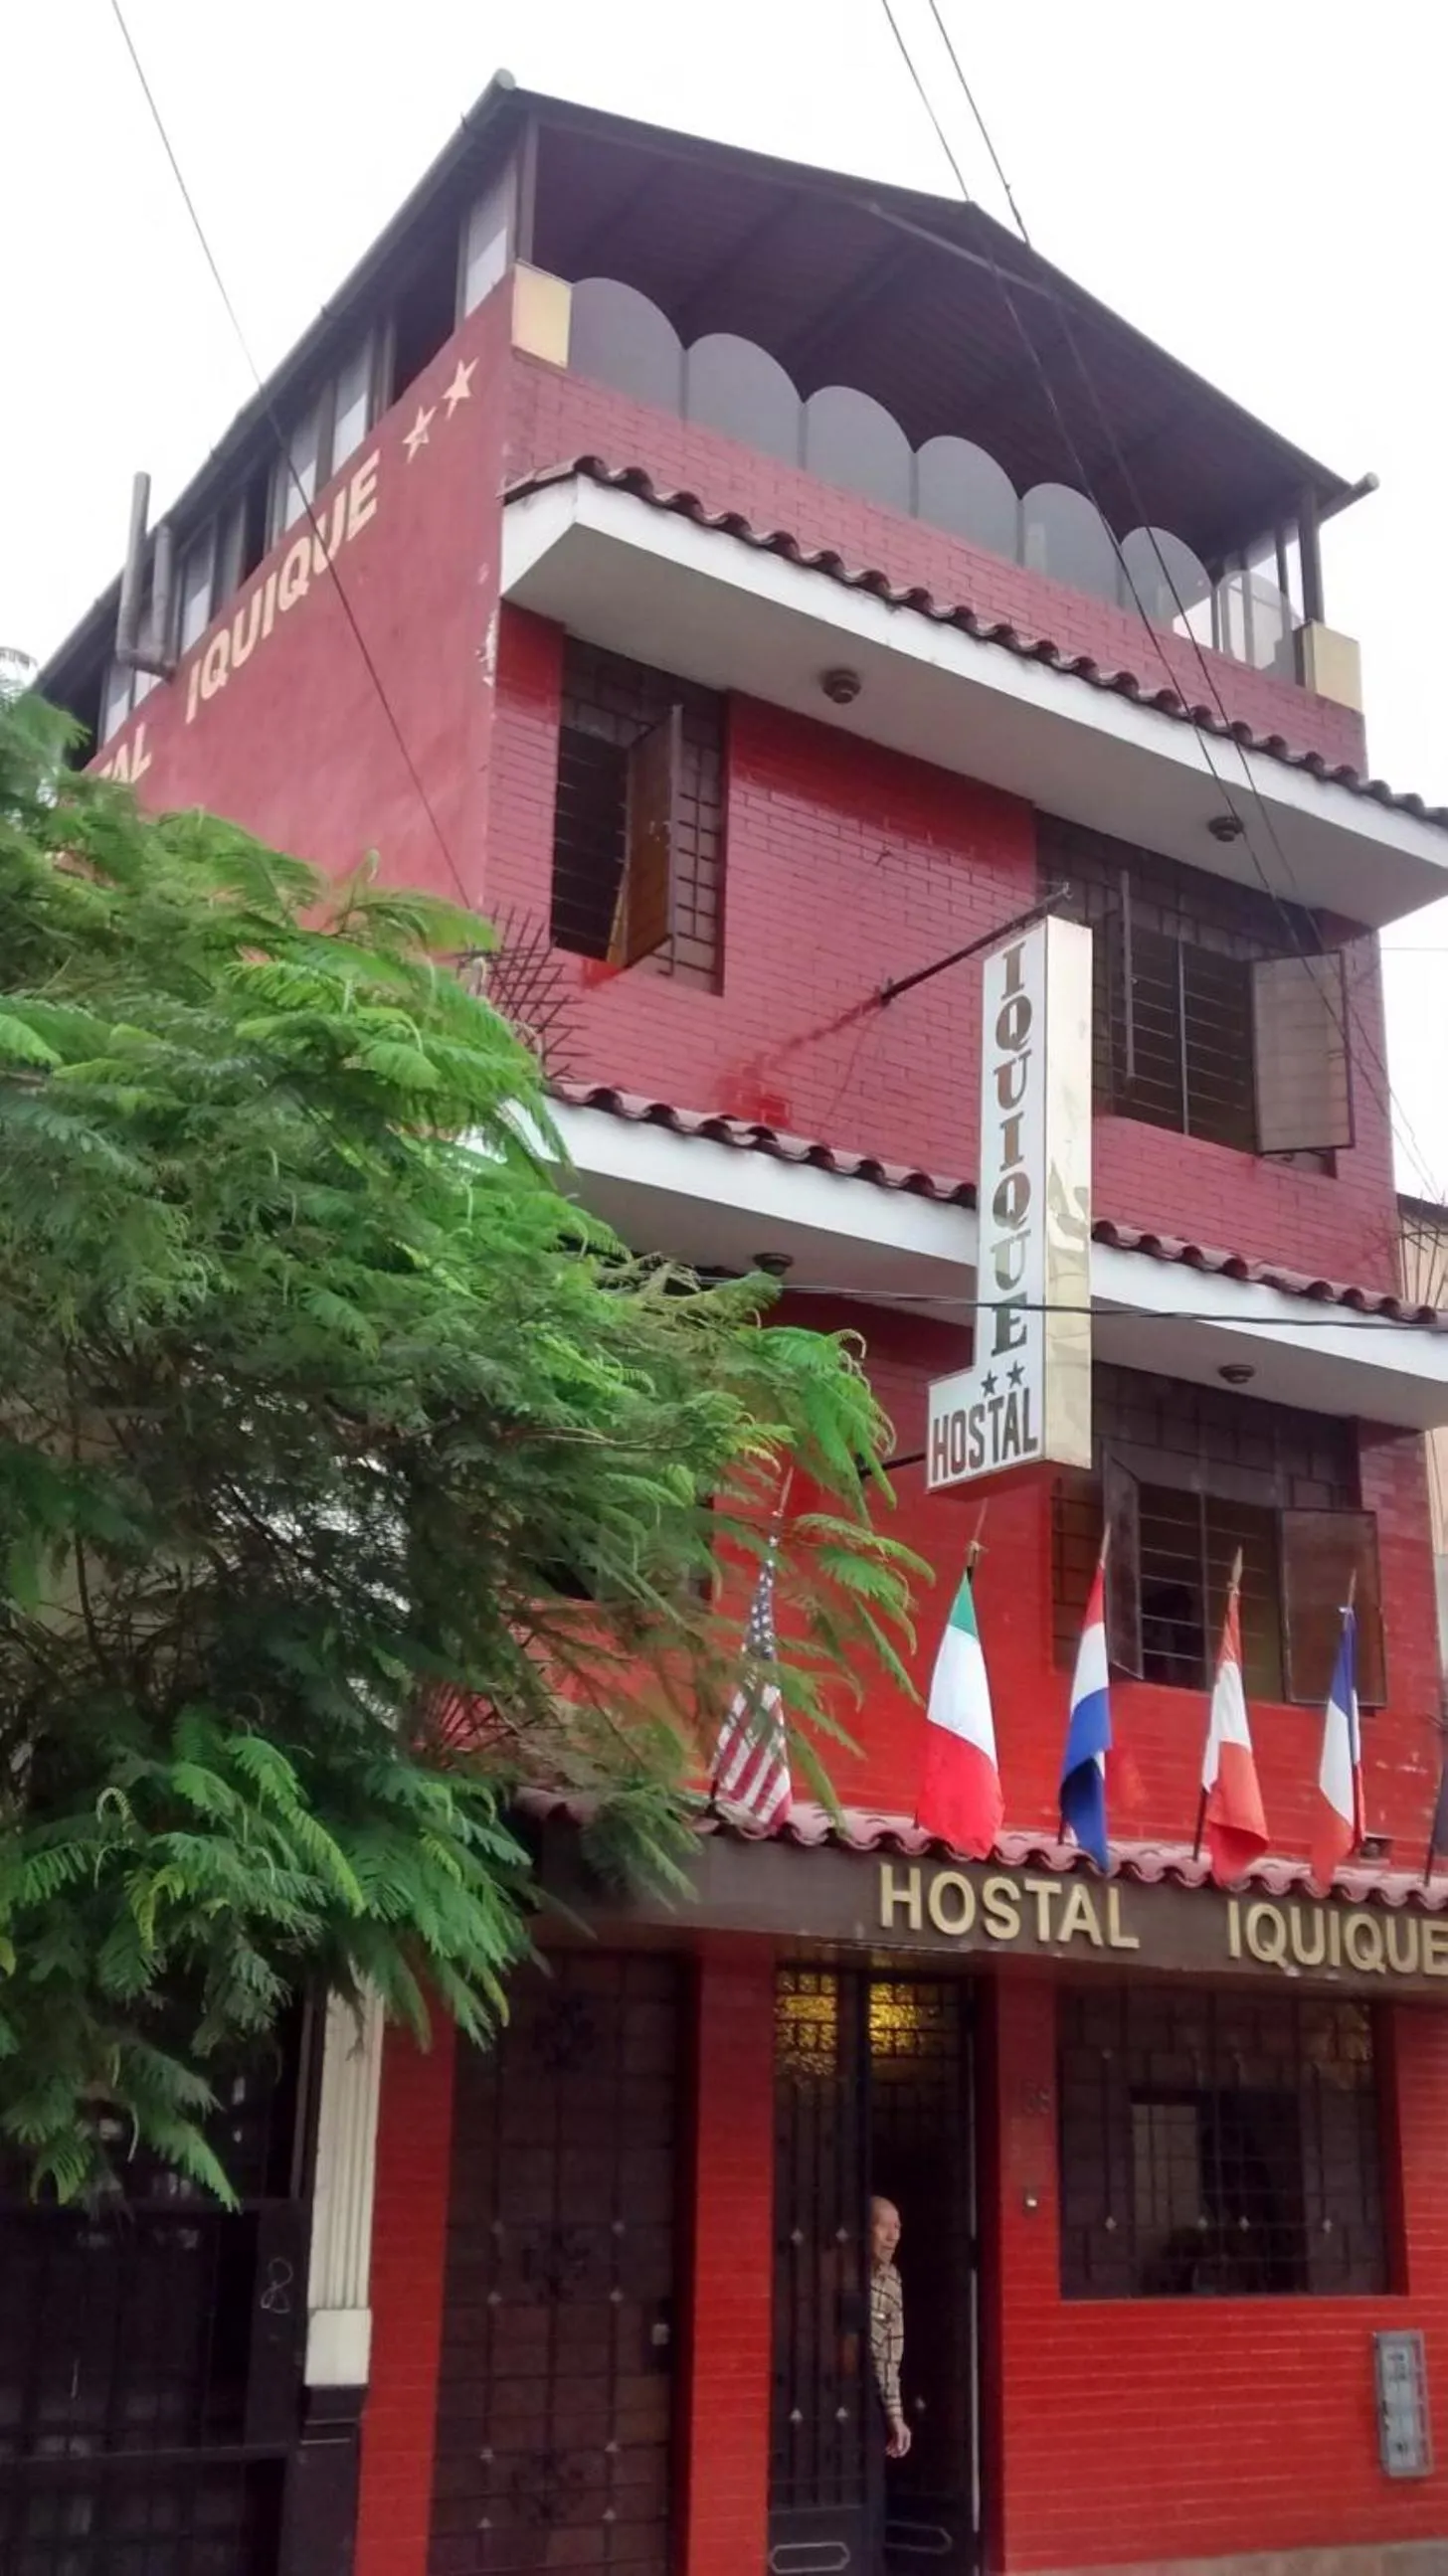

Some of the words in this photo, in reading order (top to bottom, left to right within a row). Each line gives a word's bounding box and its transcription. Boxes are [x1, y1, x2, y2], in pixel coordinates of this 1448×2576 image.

[185, 449, 381, 725] IQUIQUE
[992, 941, 1032, 1359] IQUIQUE
[933, 1387, 1038, 1483] HOSTAL
[880, 1862, 1141, 1950] HOSTAL
[1227, 1899, 1448, 1975] IQUIQUE
